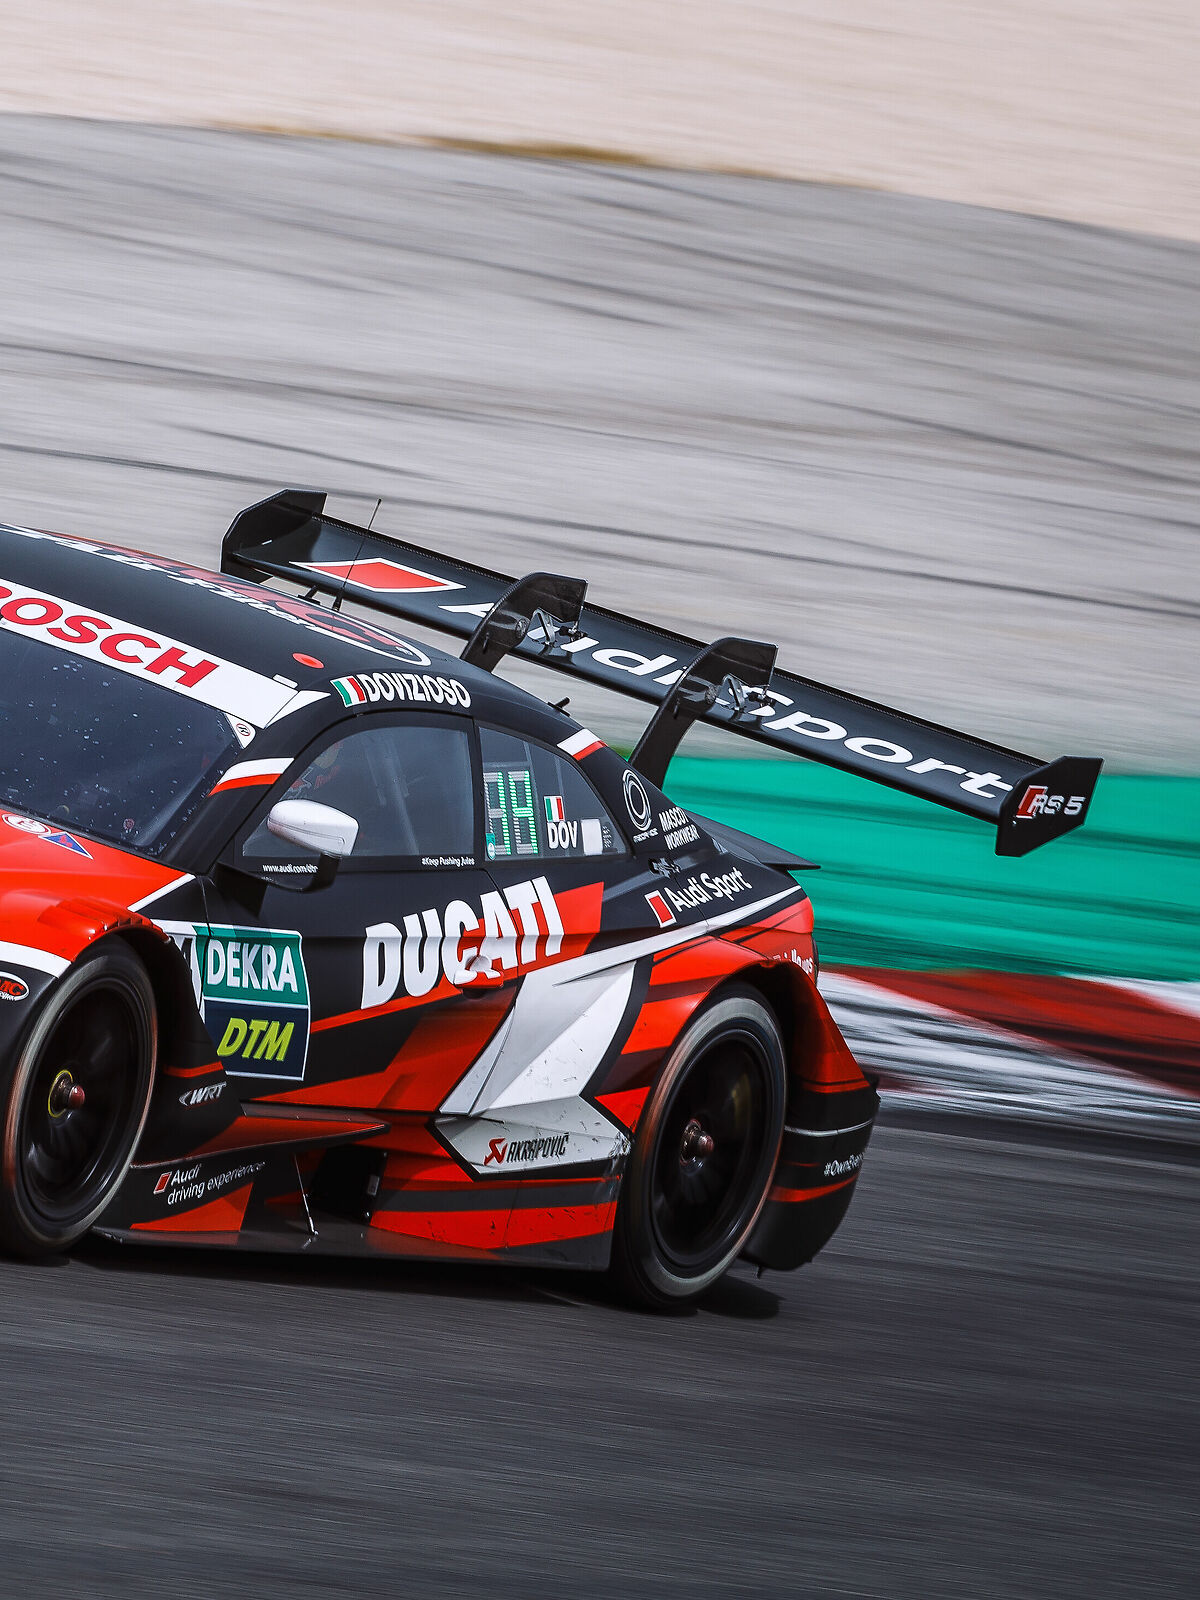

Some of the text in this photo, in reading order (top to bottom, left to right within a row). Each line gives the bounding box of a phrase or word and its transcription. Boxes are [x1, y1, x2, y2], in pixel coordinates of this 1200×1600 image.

[356, 672, 472, 708] DOVIZIOSO
[658, 806, 690, 832] MASCOT
[1028, 793, 1086, 817] RS 5
[547, 820, 578, 849] DOV
[664, 824, 701, 851] WORKWEAR
[664, 866, 753, 912] Audi Sport
[361, 876, 565, 1010] DUCATI
[207, 939, 299, 993] DEKRA
[216, 1017, 295, 1062] DTM
[189, 1081, 227, 1105] WRT
[506, 1132, 570, 1163] AKRAPOVIČ
[171, 1163, 202, 1186] Audi
[167, 1181, 206, 1205] driving
